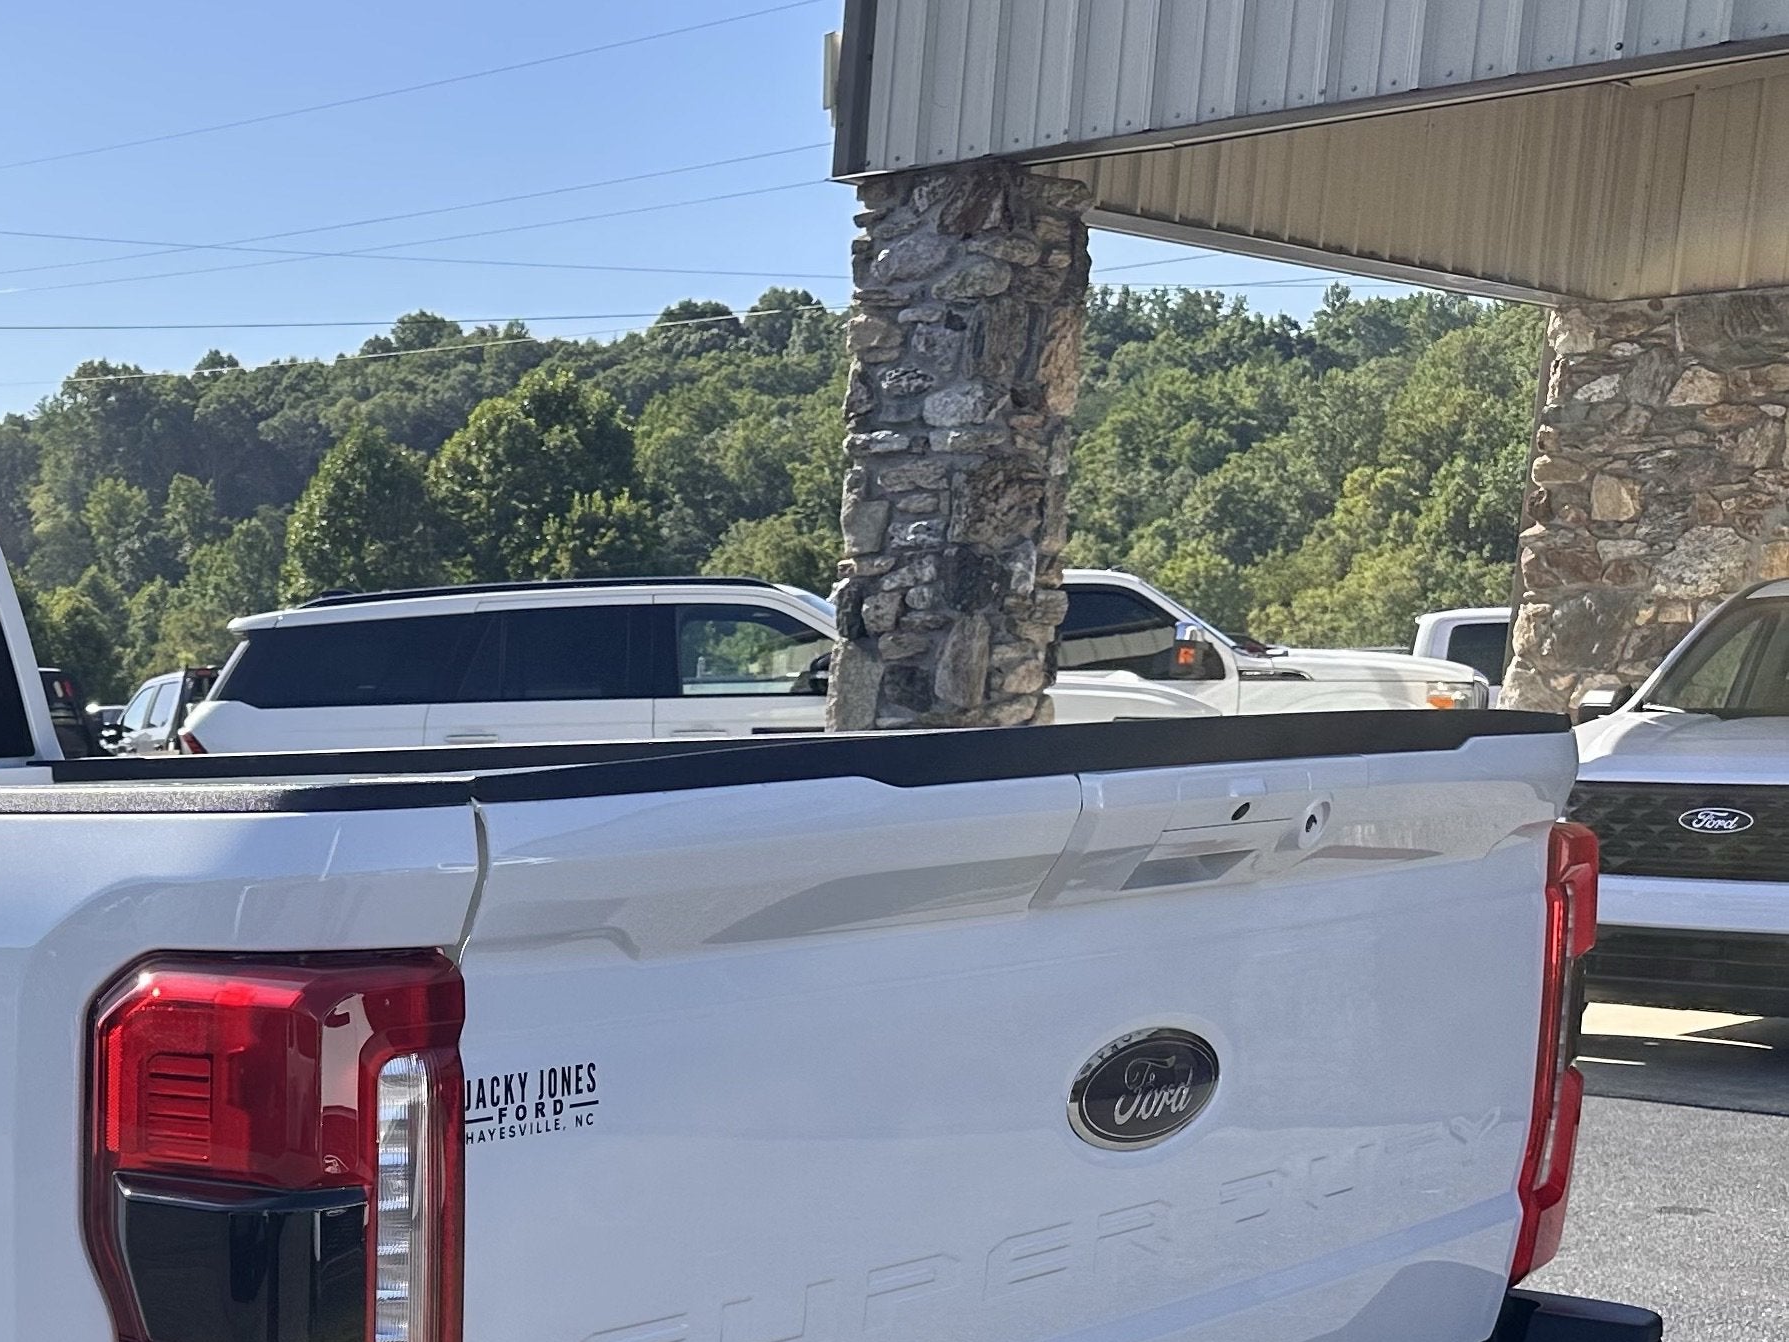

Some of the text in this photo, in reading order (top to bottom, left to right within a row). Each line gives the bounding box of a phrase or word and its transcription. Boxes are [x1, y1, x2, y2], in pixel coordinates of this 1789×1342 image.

[464, 1062, 597, 1112] JACKY JONES
[1113, 1055, 1195, 1126] Ford
[465, 1113, 595, 1145] HAYESVILLE, NC
[498, 1099, 564, 1125] FORD
